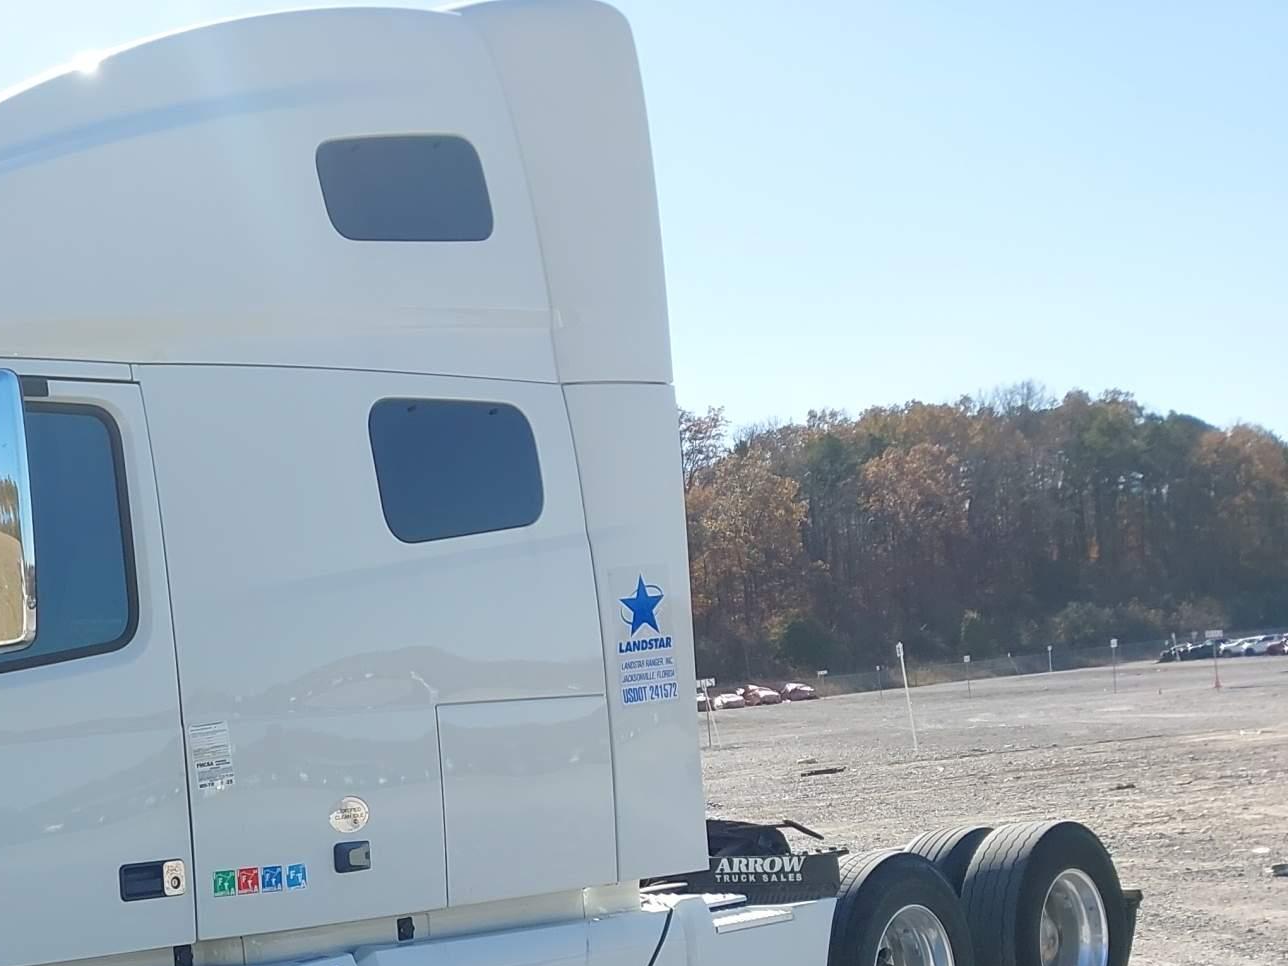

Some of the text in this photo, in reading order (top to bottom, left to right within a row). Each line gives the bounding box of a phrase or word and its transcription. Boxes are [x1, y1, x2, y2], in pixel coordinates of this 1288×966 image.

[618, 636, 672, 653] LANDSTAR
[622, 682, 678, 704] USDOT 241572
[715, 856, 806, 873] ARROW
[715, 873, 803, 882] TRUCK SALES
